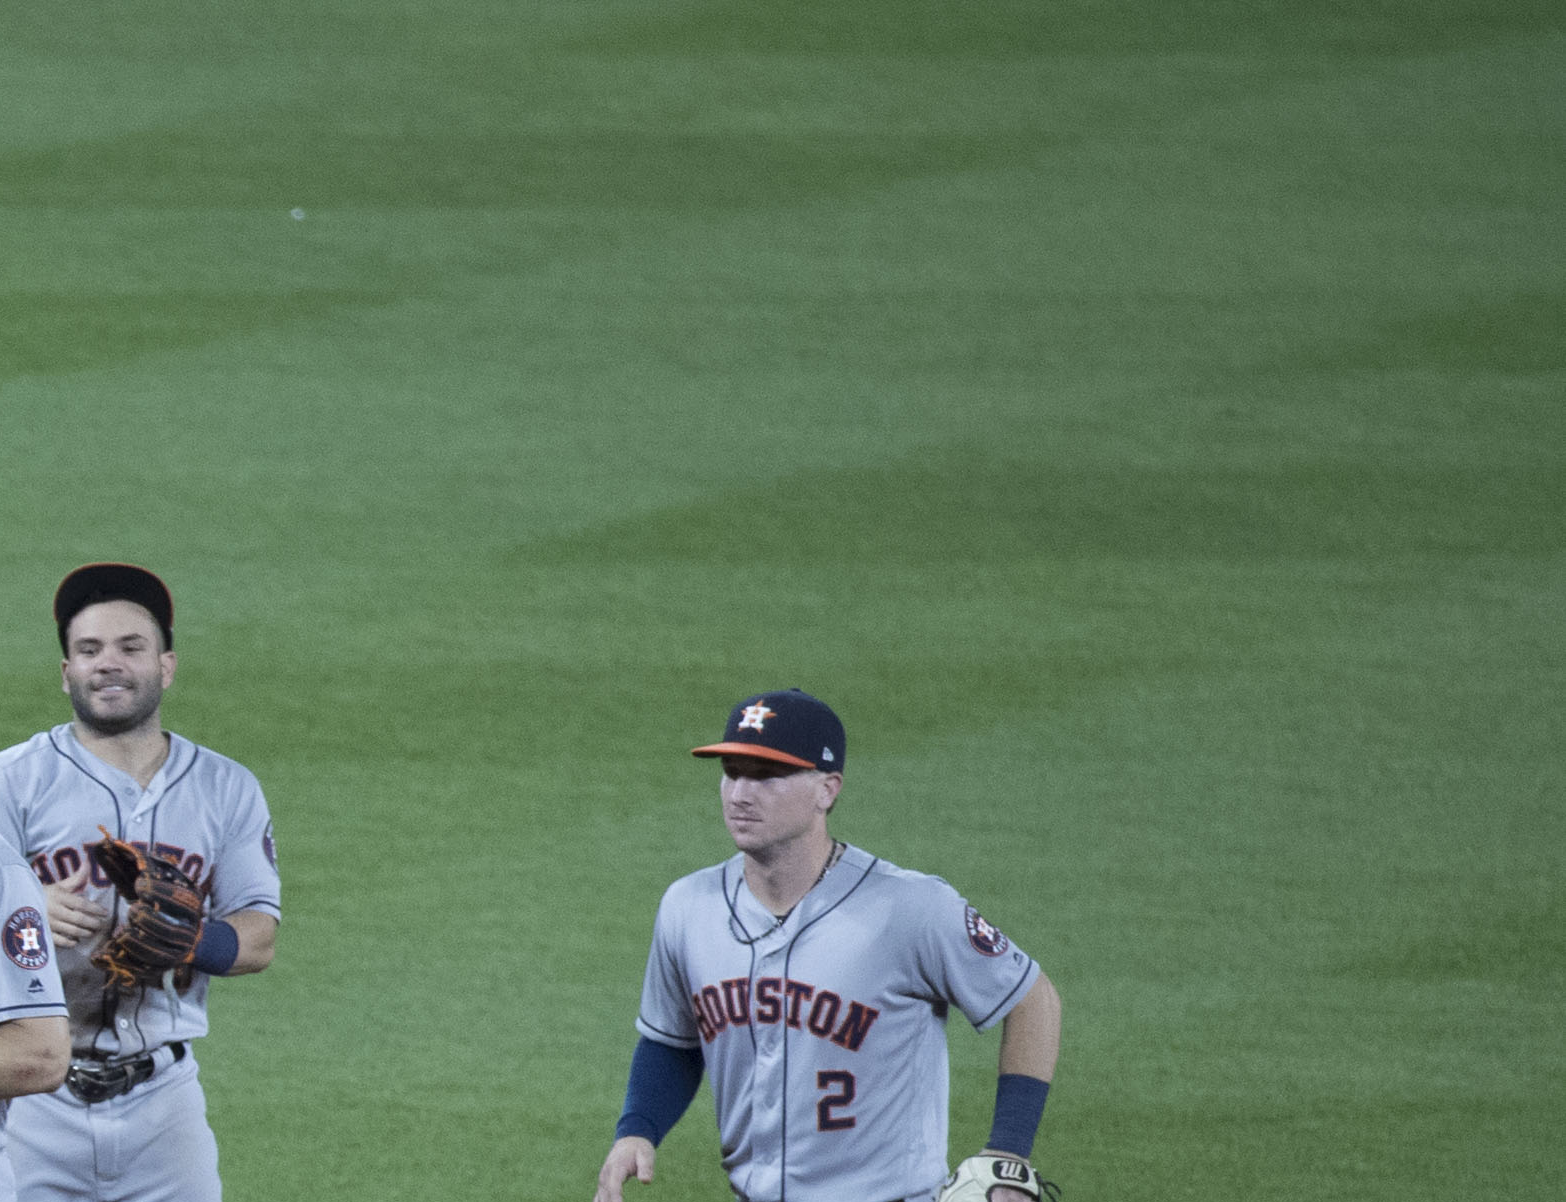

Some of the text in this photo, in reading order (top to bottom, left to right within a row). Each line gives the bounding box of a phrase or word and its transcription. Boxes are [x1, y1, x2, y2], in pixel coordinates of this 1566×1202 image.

[738, 706, 772, 729] H
[692, 977, 881, 1053] HOUSTON
[817, 1070, 856, 1132] 2
